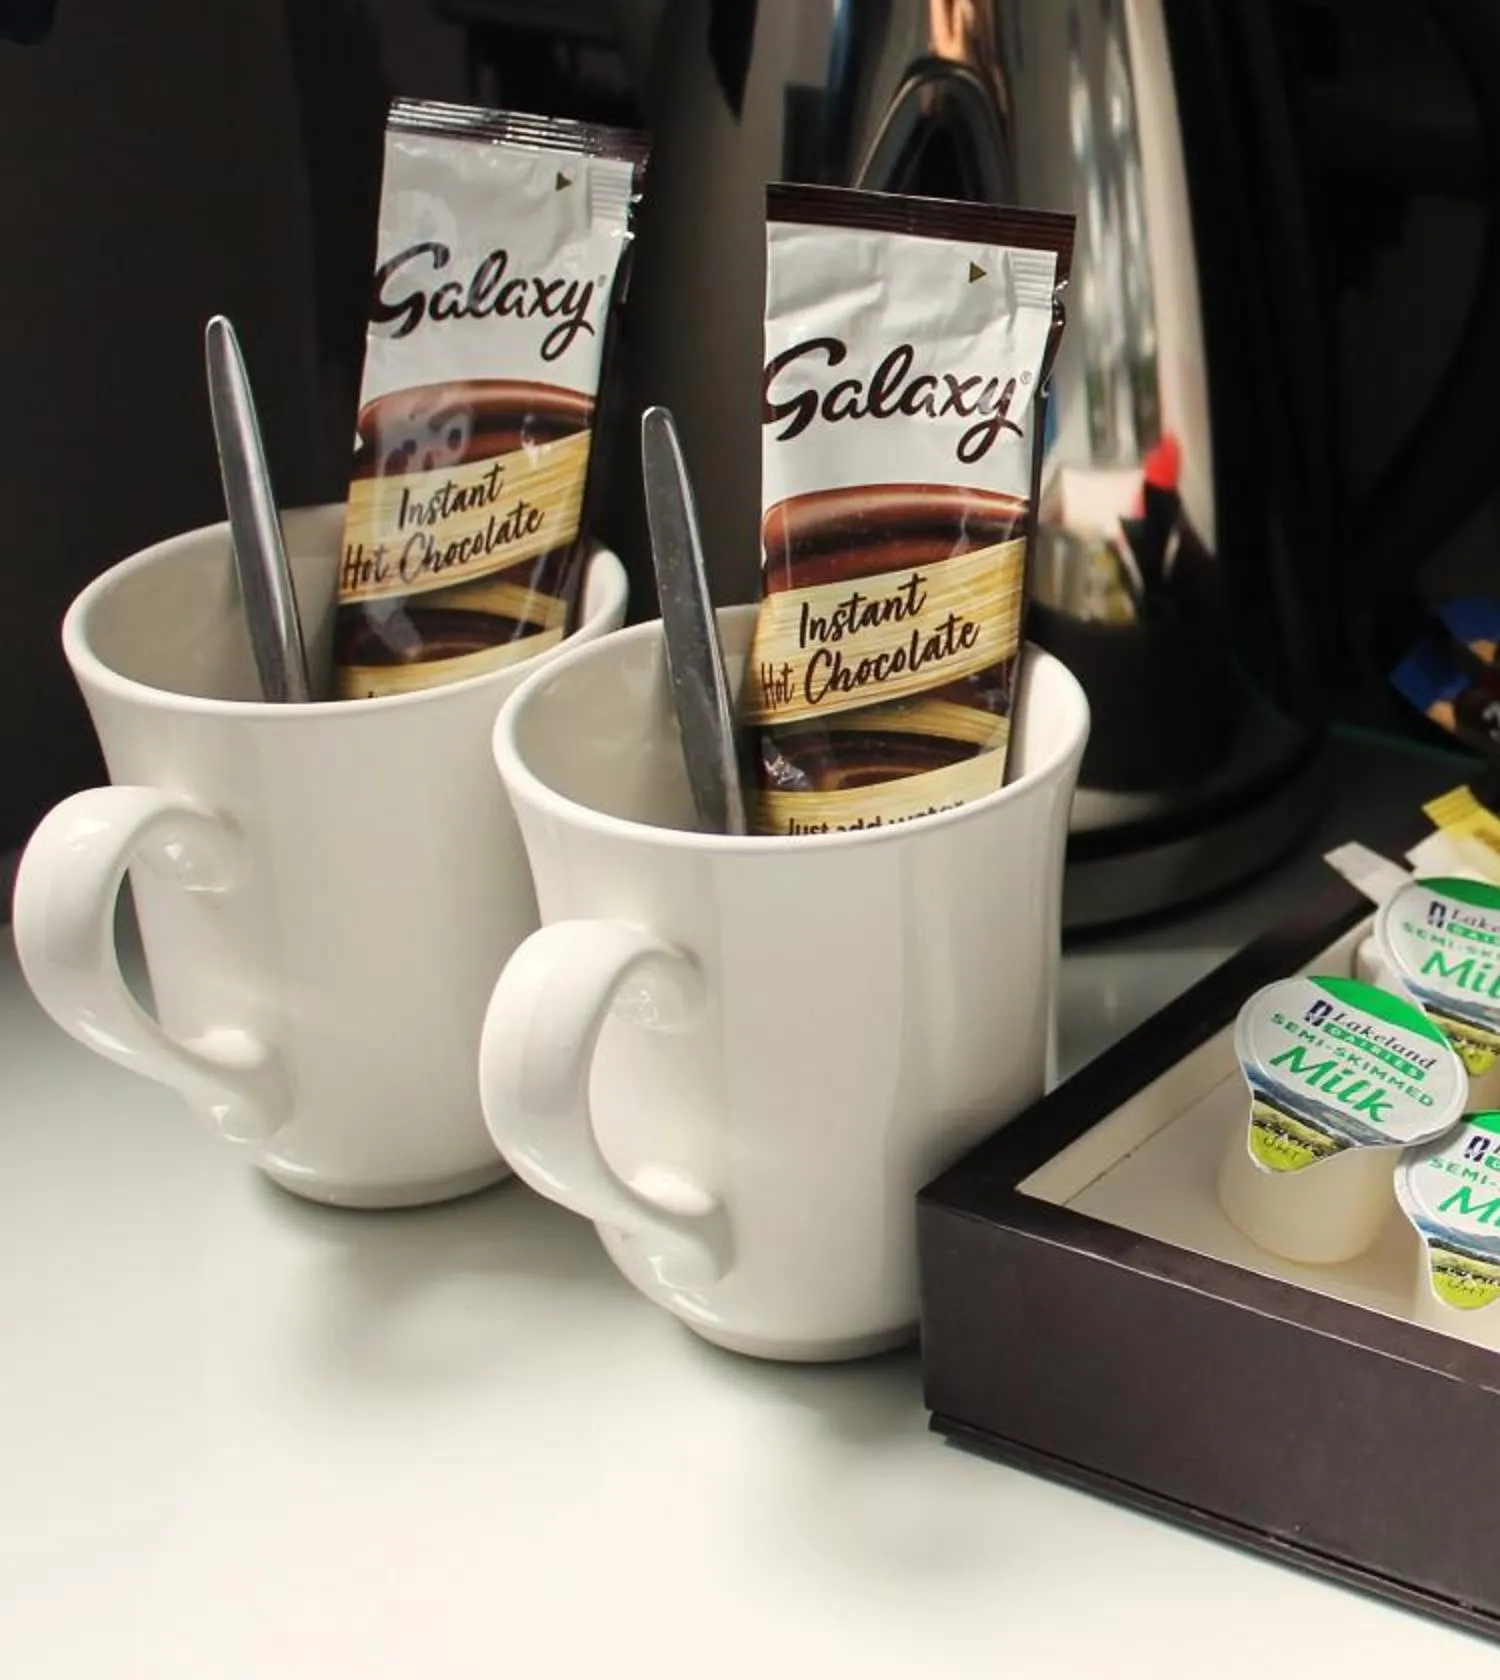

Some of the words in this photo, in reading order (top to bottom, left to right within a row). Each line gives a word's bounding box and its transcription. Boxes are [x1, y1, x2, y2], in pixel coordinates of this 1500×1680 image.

[373, 242, 596, 362] Galaxy
[763, 337, 1025, 464] Galaxy
[398, 463, 505, 530] Instant
[342, 543, 389, 590] Hot
[398, 500, 545, 584] Chocolate
[799, 572, 927, 649] Instant
[761, 661, 795, 711] Hot
[804, 613, 981, 705] Chocolate
[1269, 1012, 1435, 1108] SEMI-SKIMMED
[1269, 1045, 1393, 1122] Milk
[1332, 1011, 1438, 1070] Lakeland
